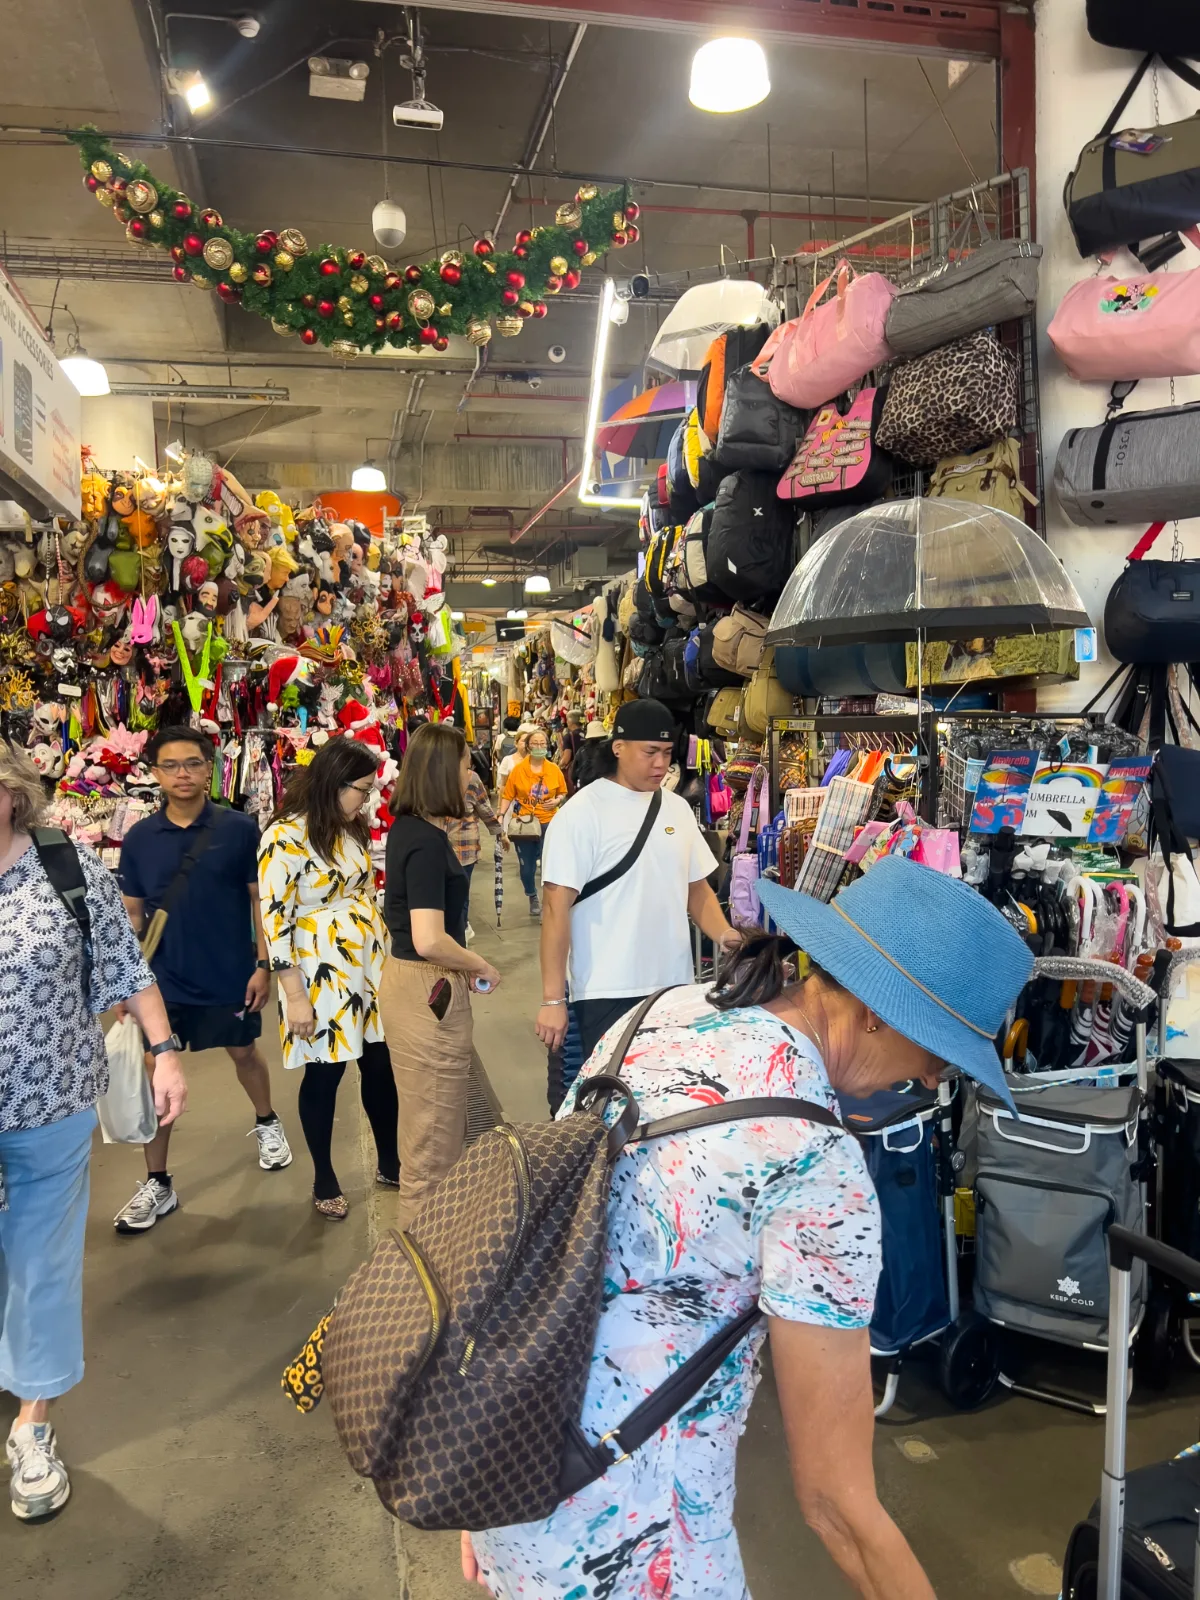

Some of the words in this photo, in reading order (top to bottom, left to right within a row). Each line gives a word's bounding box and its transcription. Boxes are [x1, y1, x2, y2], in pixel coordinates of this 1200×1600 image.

[18, 319, 54, 381] ACCESSORIES
[1115, 428, 1133, 467] TOSCA
[802, 470, 835, 484] AUSTRALIA
[992, 755, 1031, 766] Umbrella
[1030, 792, 1086, 805] UMBRELLA
[1050, 1293, 1069, 1302] KEEP
[1071, 1297, 1095, 1306] COLD
